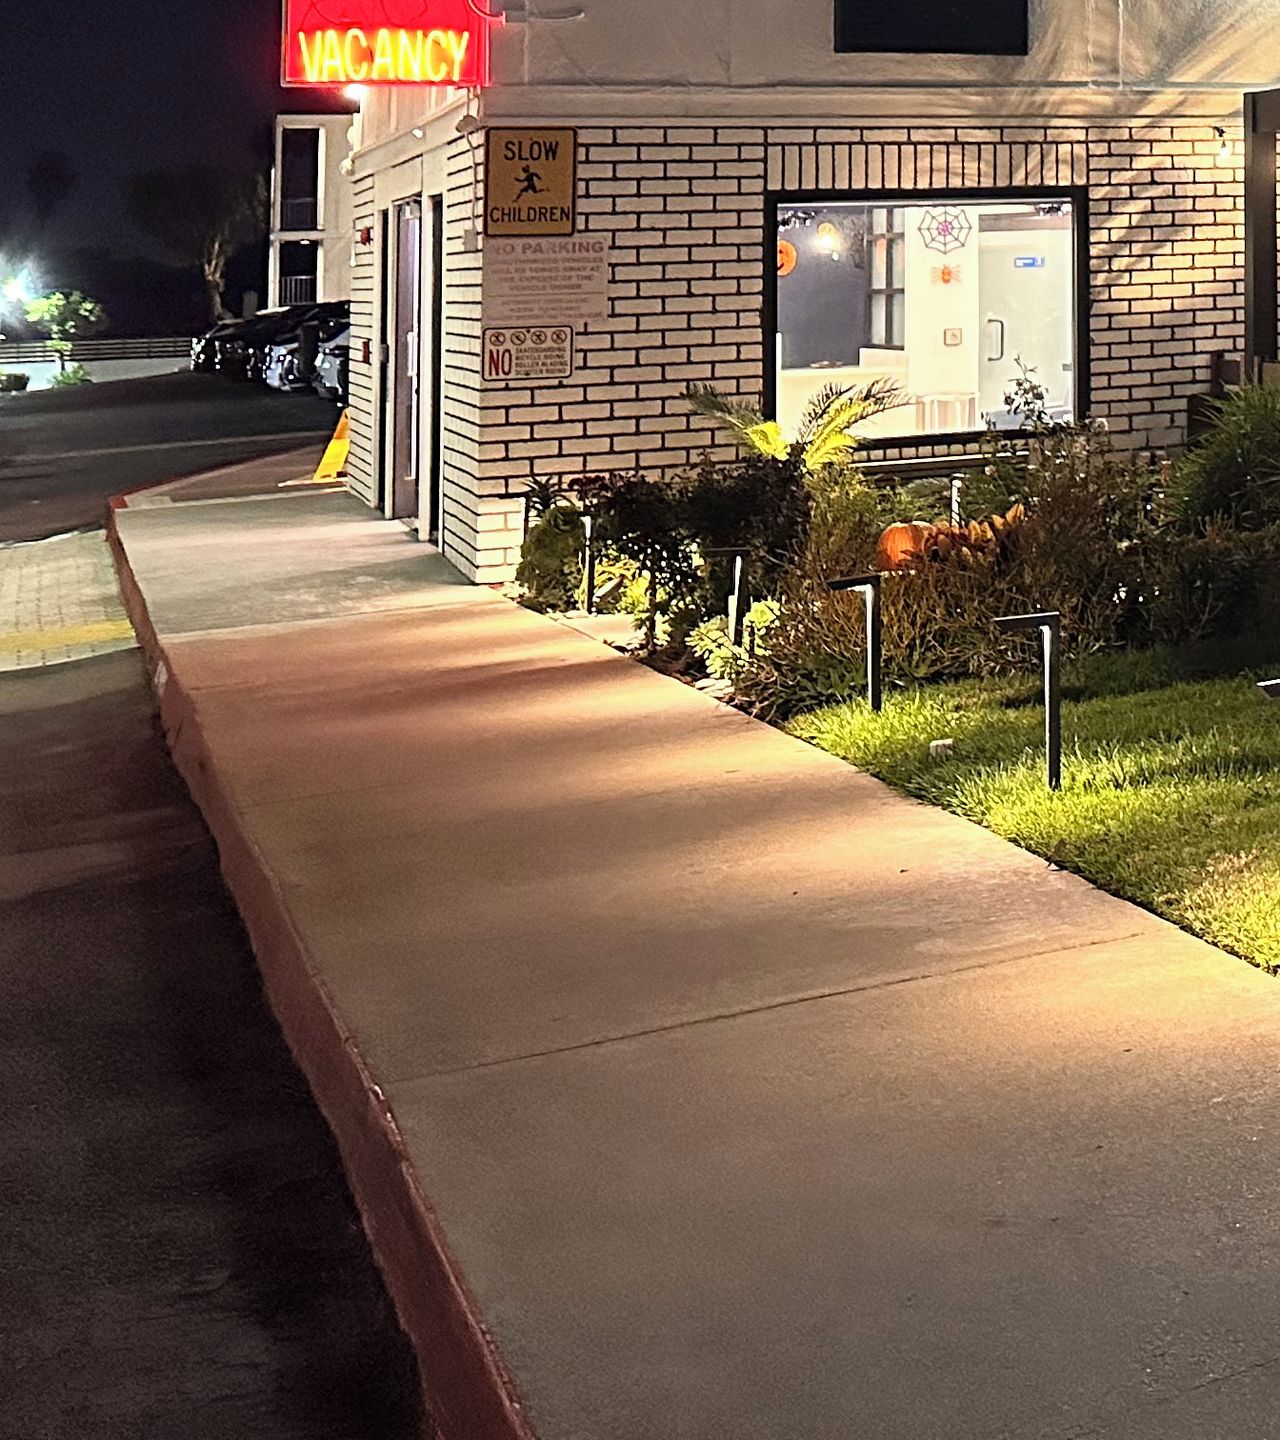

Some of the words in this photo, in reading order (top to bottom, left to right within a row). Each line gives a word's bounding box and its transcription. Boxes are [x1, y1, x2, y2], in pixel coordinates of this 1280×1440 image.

[298, 27, 470, 83] VACANCY
[503, 140, 559, 161] SLOW
[489, 206, 570, 223] CHILDREN
[522, 240, 604, 254] PARKING
[488, 348, 512, 376] NO
